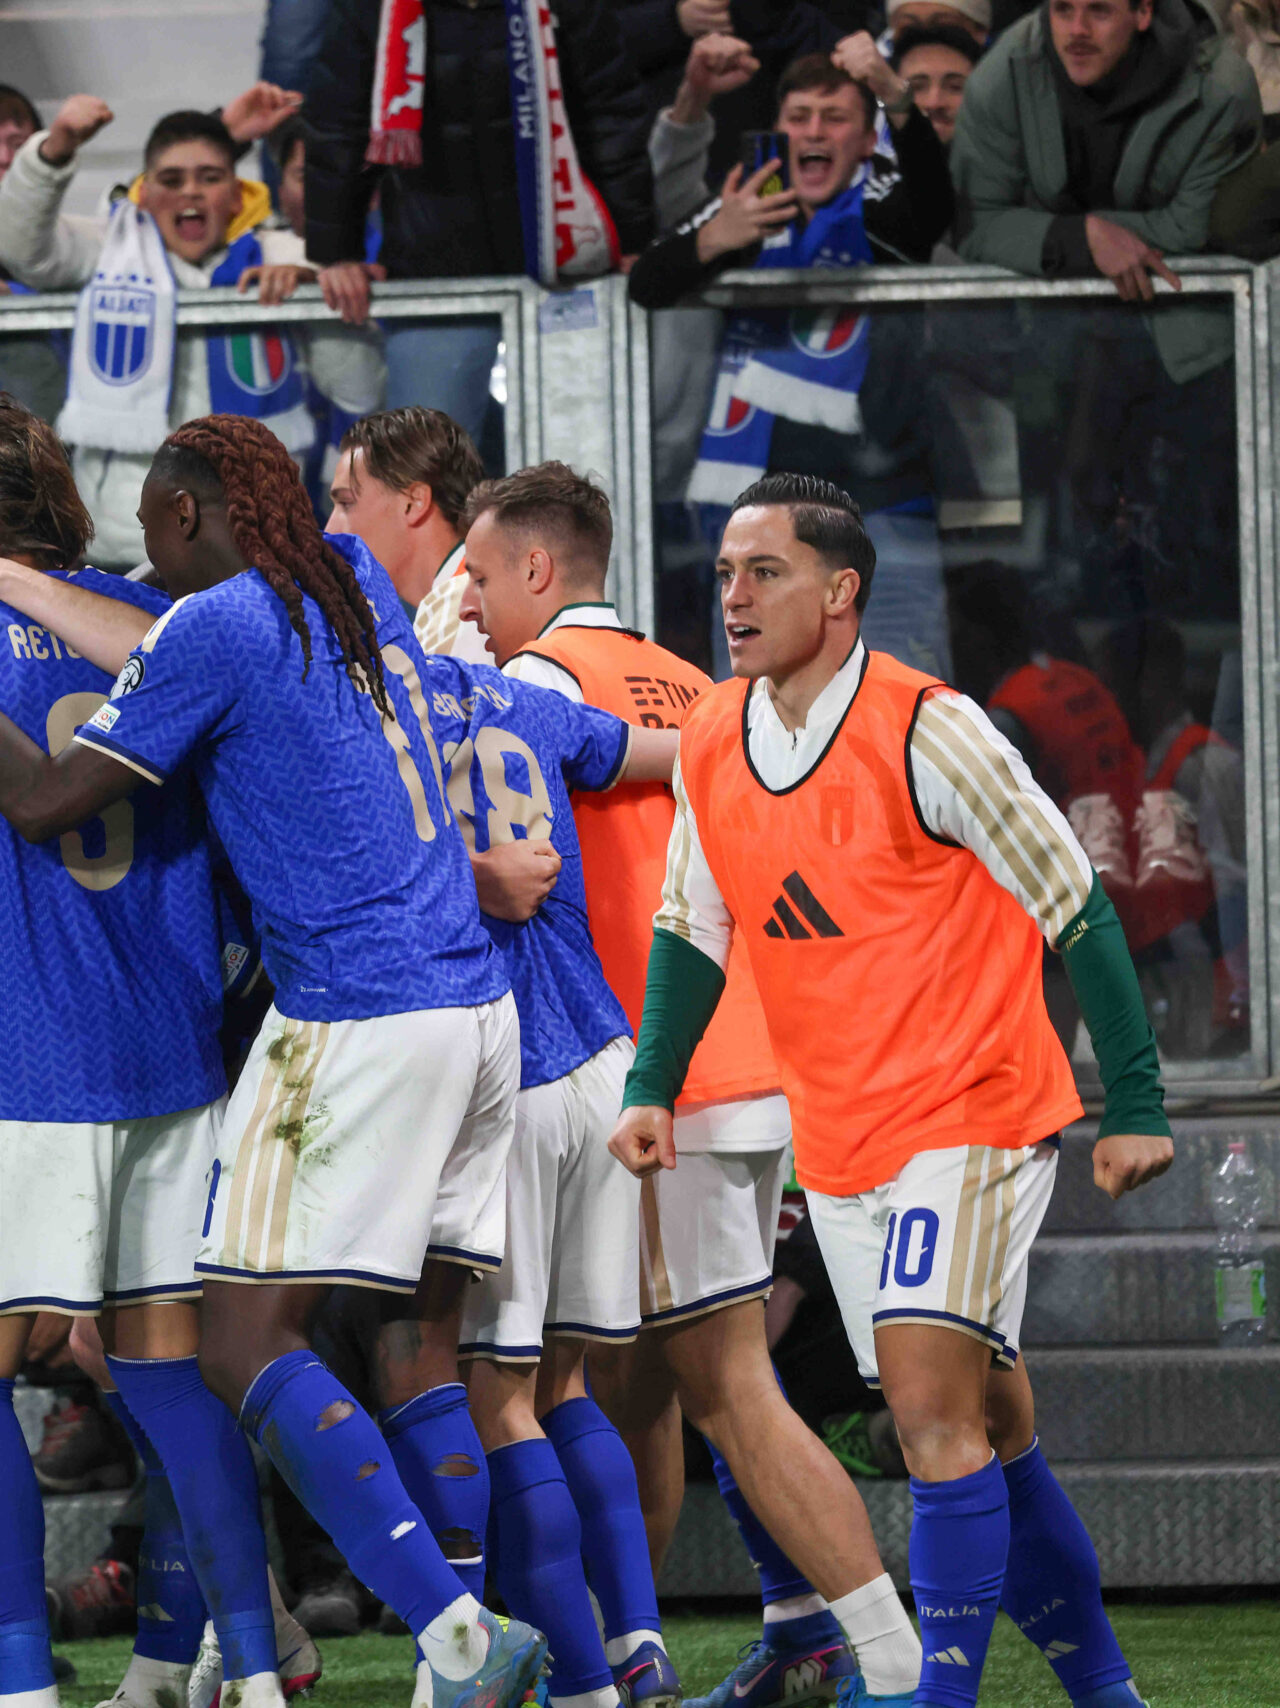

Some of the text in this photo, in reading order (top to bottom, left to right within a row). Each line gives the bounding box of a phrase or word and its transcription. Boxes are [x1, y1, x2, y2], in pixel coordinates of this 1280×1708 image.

[507, 13, 535, 139] MILANO
[879, 1206, 940, 1291] 10
[920, 1604, 981, 1618] ITALIA
